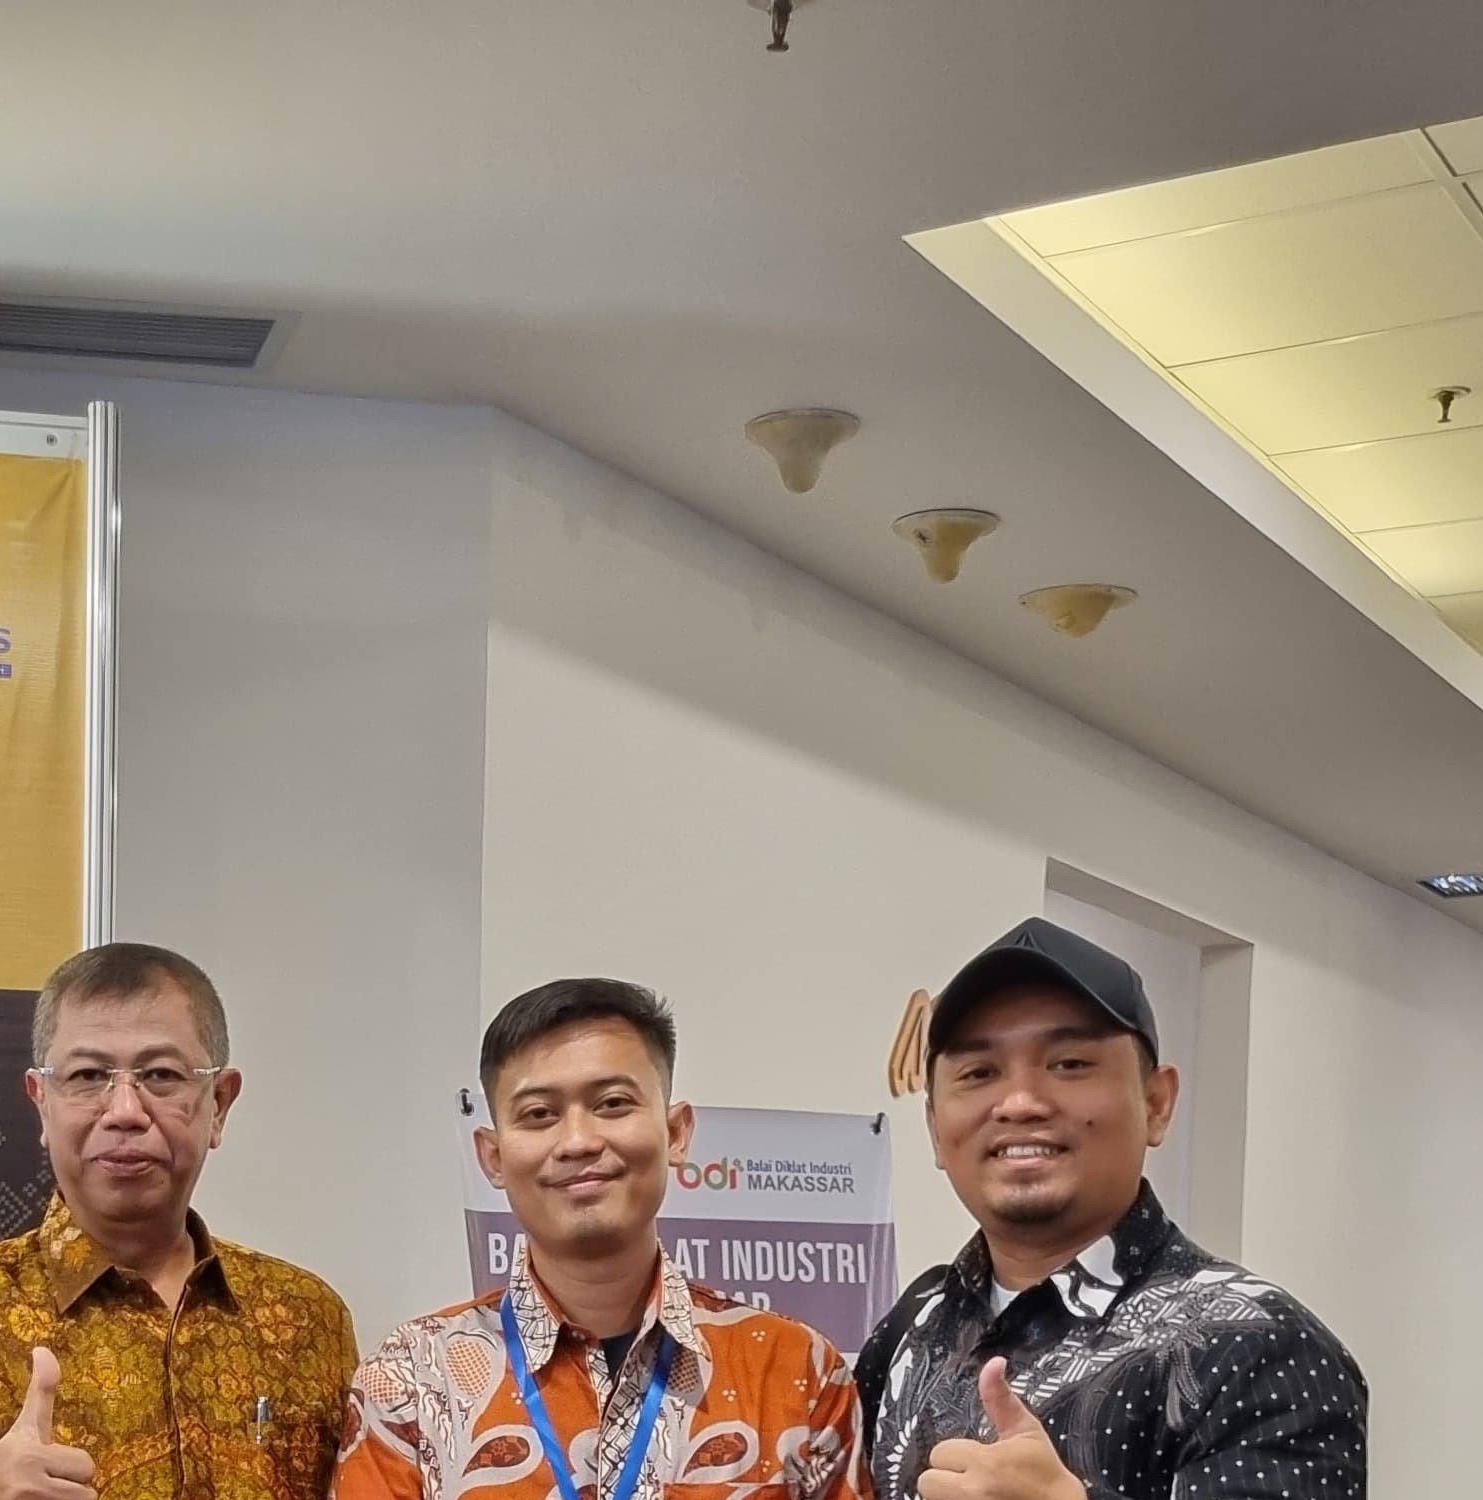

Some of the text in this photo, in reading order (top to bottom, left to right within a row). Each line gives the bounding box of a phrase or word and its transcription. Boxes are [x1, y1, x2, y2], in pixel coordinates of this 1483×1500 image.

[746, 1159, 852, 1176] Balai Diklat Industri
[747, 1174, 855, 1194] MAKASSAR
[720, 1239, 868, 1284] INDUSTRI
